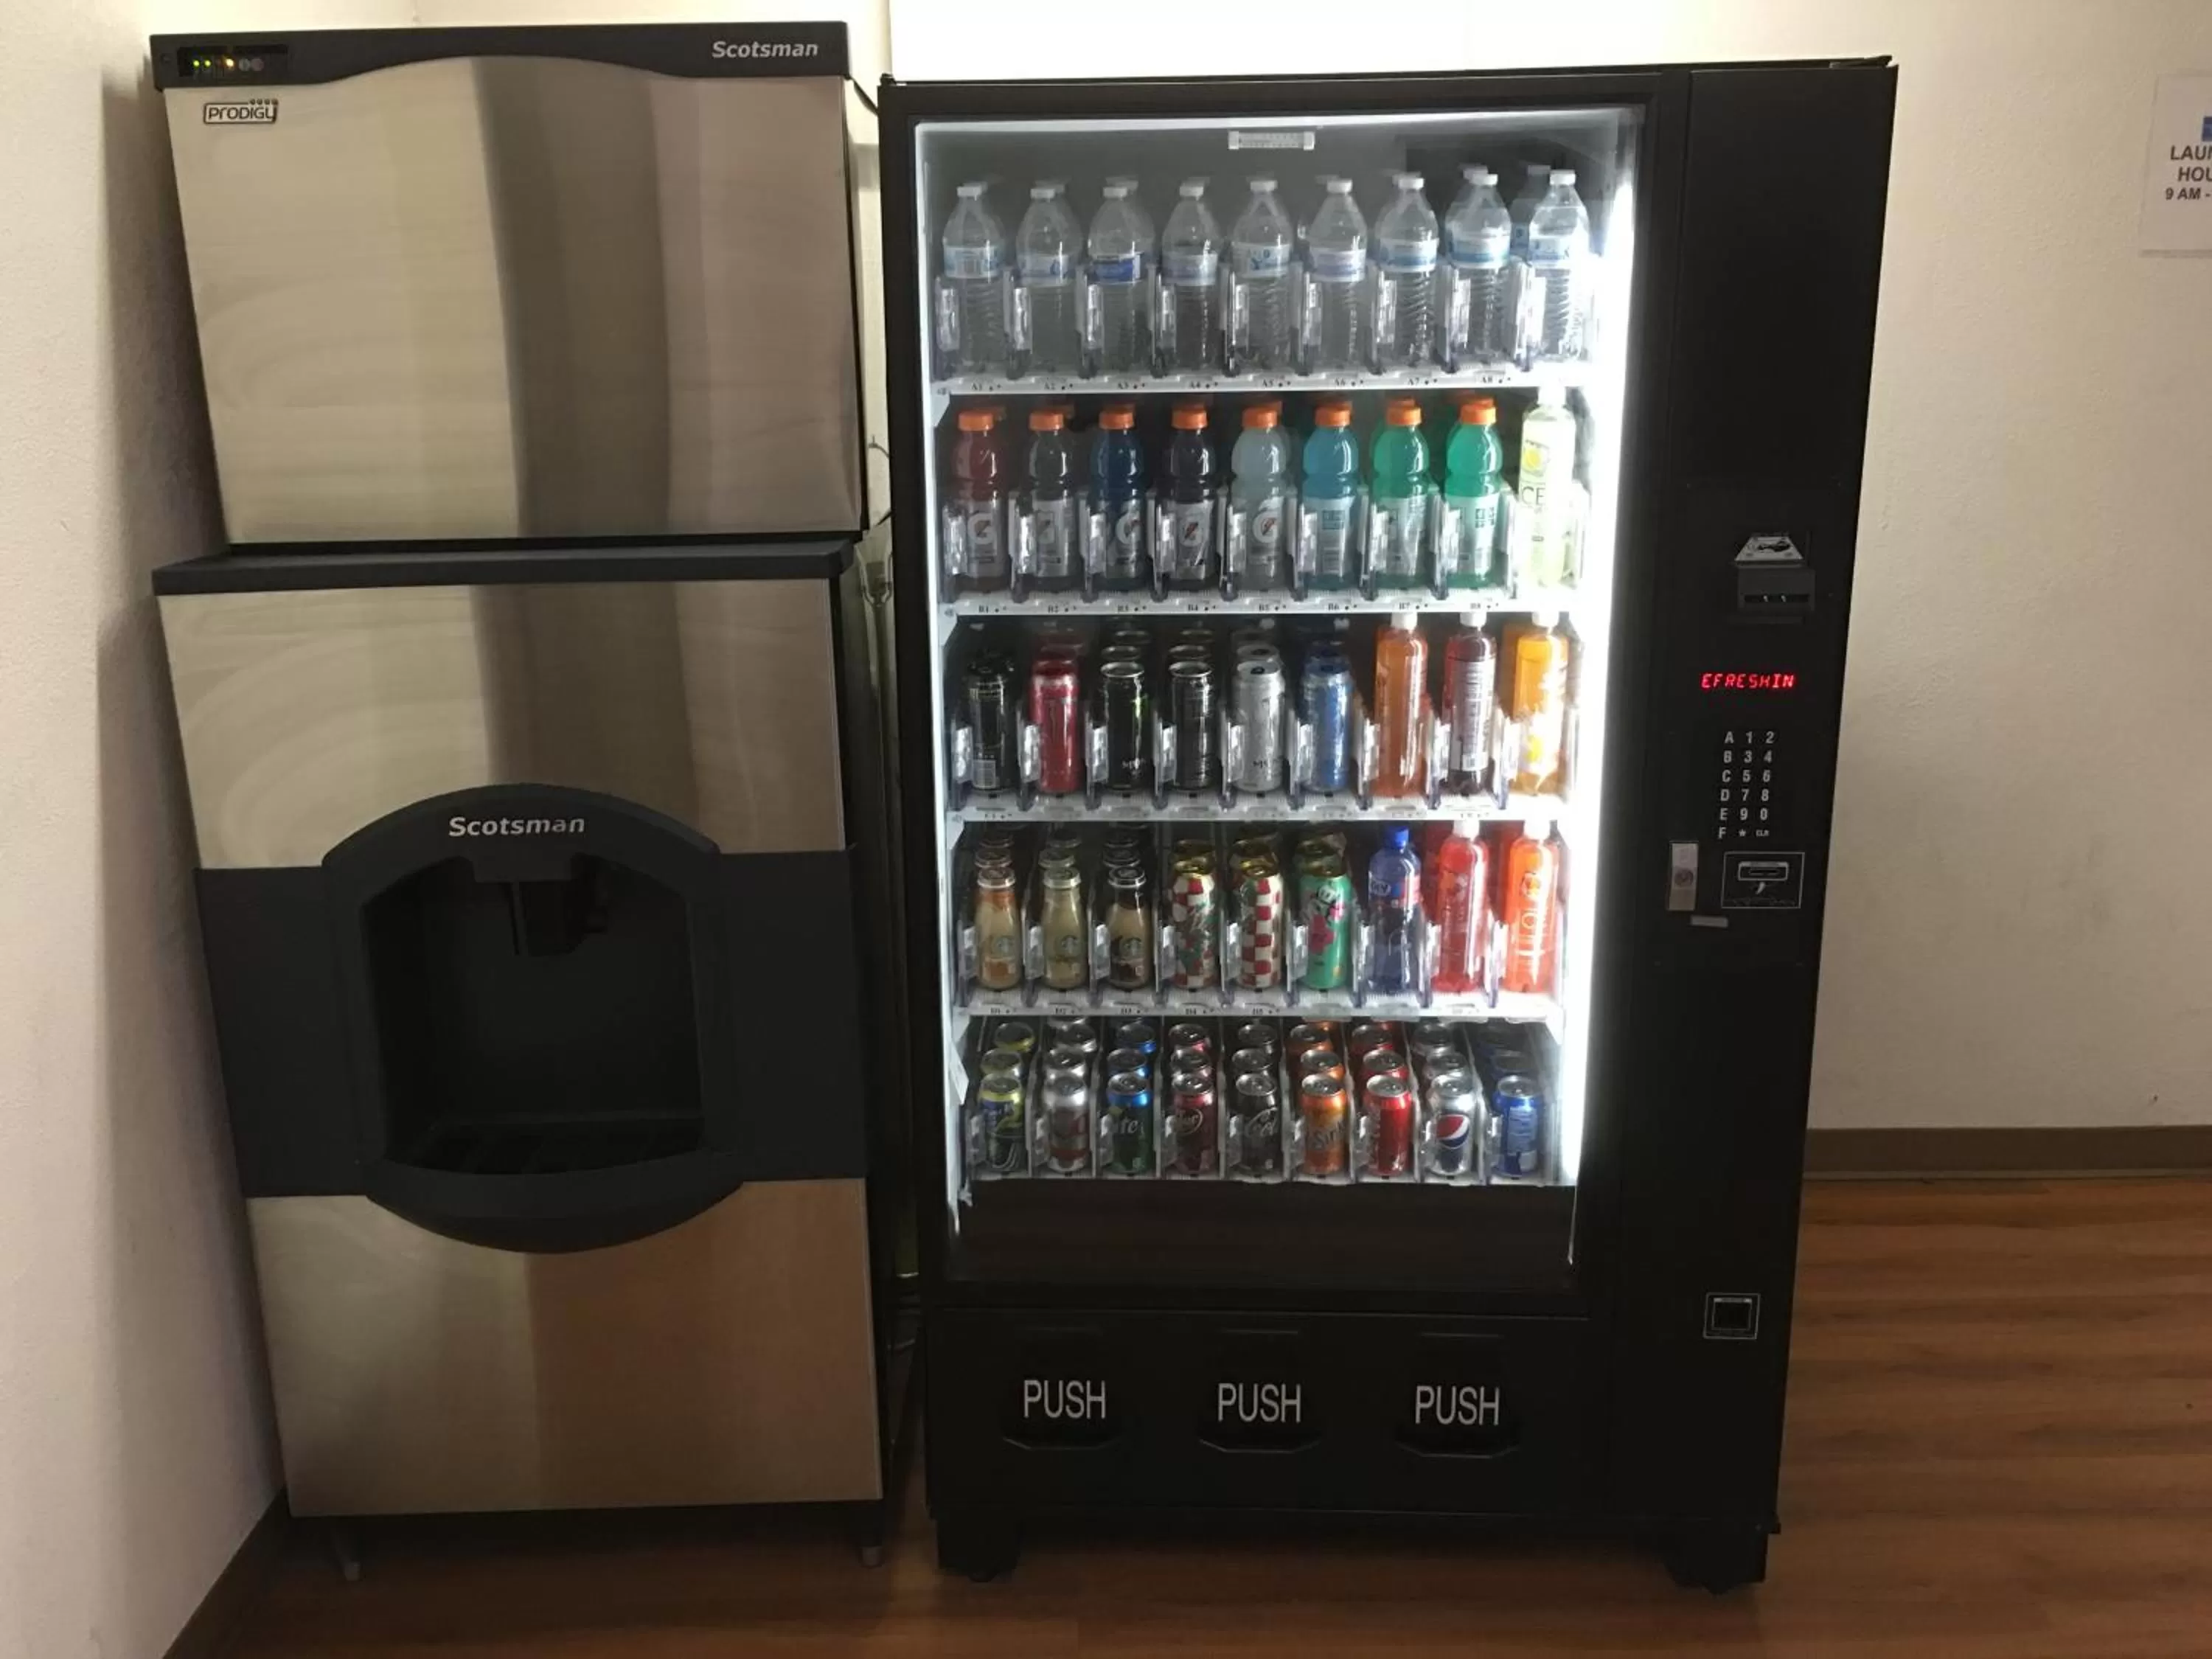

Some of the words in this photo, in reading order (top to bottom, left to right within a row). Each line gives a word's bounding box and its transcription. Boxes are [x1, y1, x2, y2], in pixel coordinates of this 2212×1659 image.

[712, 41, 819, 58] Scotsman
[2165, 187, 2174, 201] 9
[2177, 187, 2202, 201] AM
[1700, 672, 1795, 689] EFRESHIN
[1725, 731, 1734, 744] A
[1745, 731, 1753, 744] 1
[1765, 731, 1775, 744] 2
[1723, 750, 1732, 763] B
[1744, 750, 1753, 763] 3
[1764, 750, 1773, 763] 4
[1722, 769, 1732, 782] C
[1742, 769, 1751, 782] 5
[1762, 769, 1771, 782] 6
[1720, 788, 1730, 801] D
[1741, 788, 1750, 801] 7
[1761, 788, 1770, 801] 8
[1719, 807, 1728, 821] E
[1739, 807, 1748, 821] 9
[1760, 807, 1768, 821] 0
[448, 816, 585, 837] Scotsman
[1718, 827, 1727, 839] F
[1023, 1380, 1106, 1419] PUSH
[1218, 1382, 1301, 1423] PUSH
[1416, 1385, 1500, 1426] PUSH
